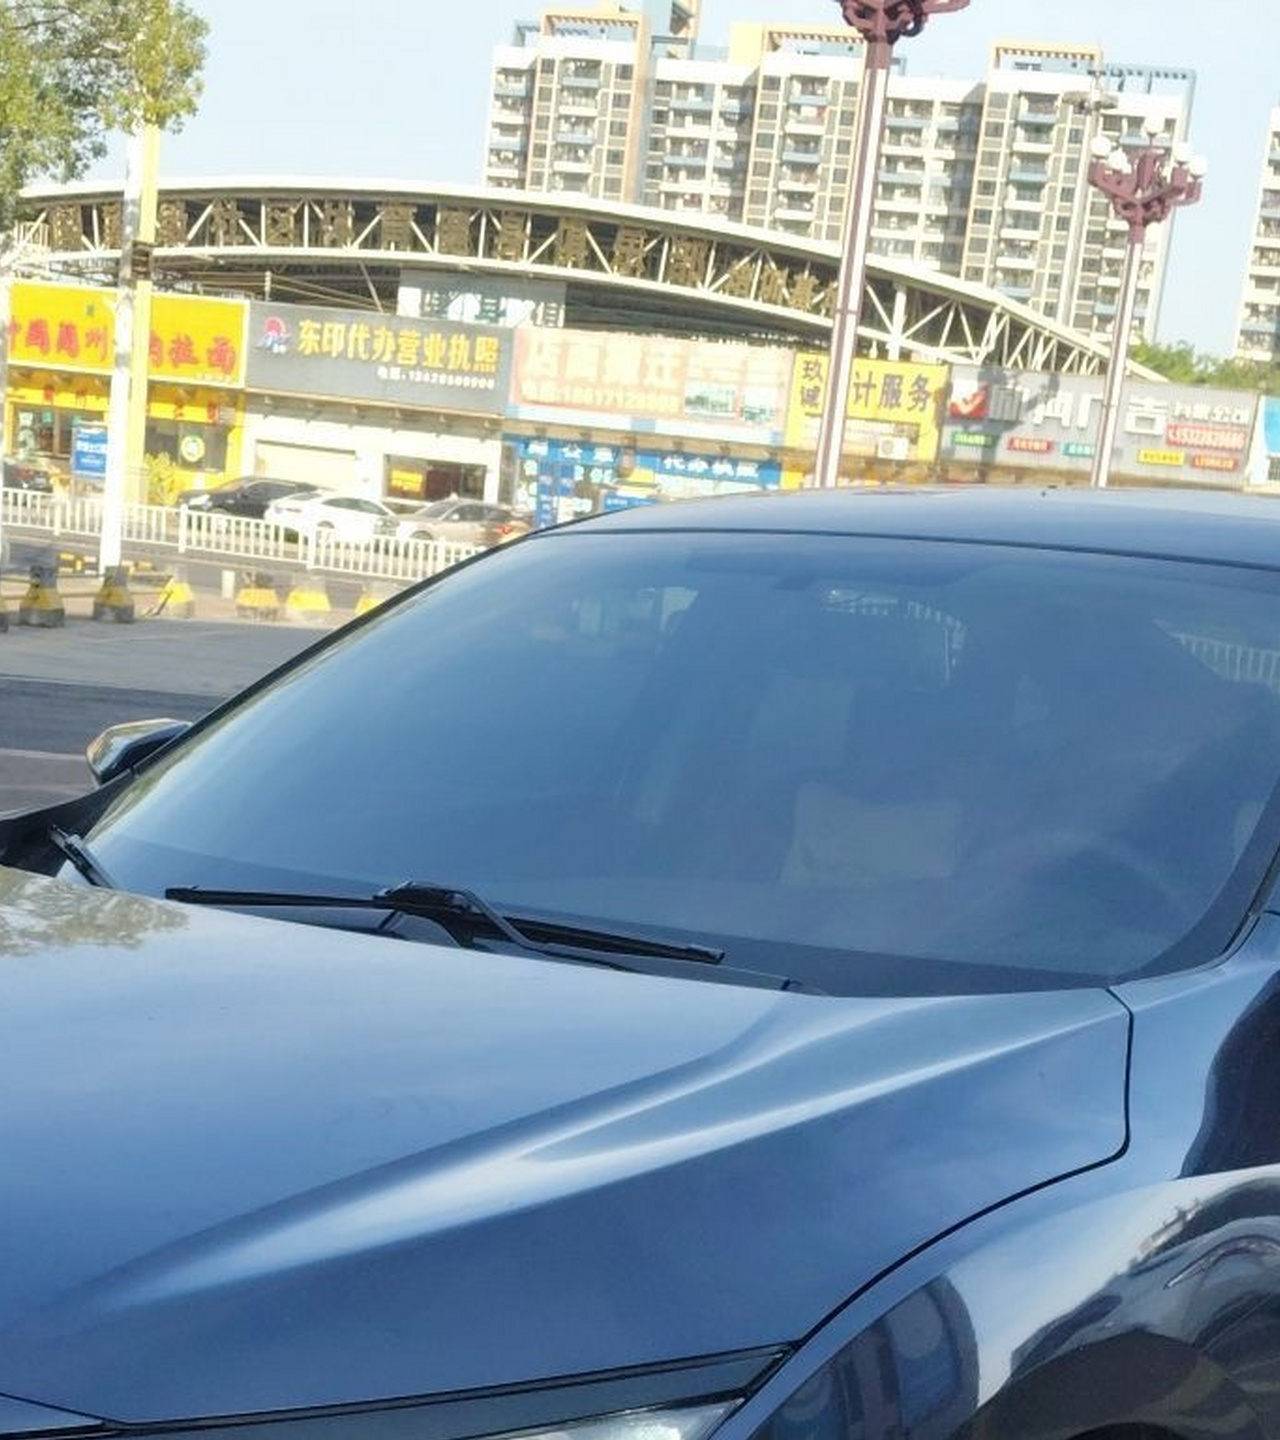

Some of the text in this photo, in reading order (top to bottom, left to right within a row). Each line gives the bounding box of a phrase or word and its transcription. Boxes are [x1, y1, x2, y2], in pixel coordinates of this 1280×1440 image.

[297, 319, 500, 373] 东印代办营业执照
